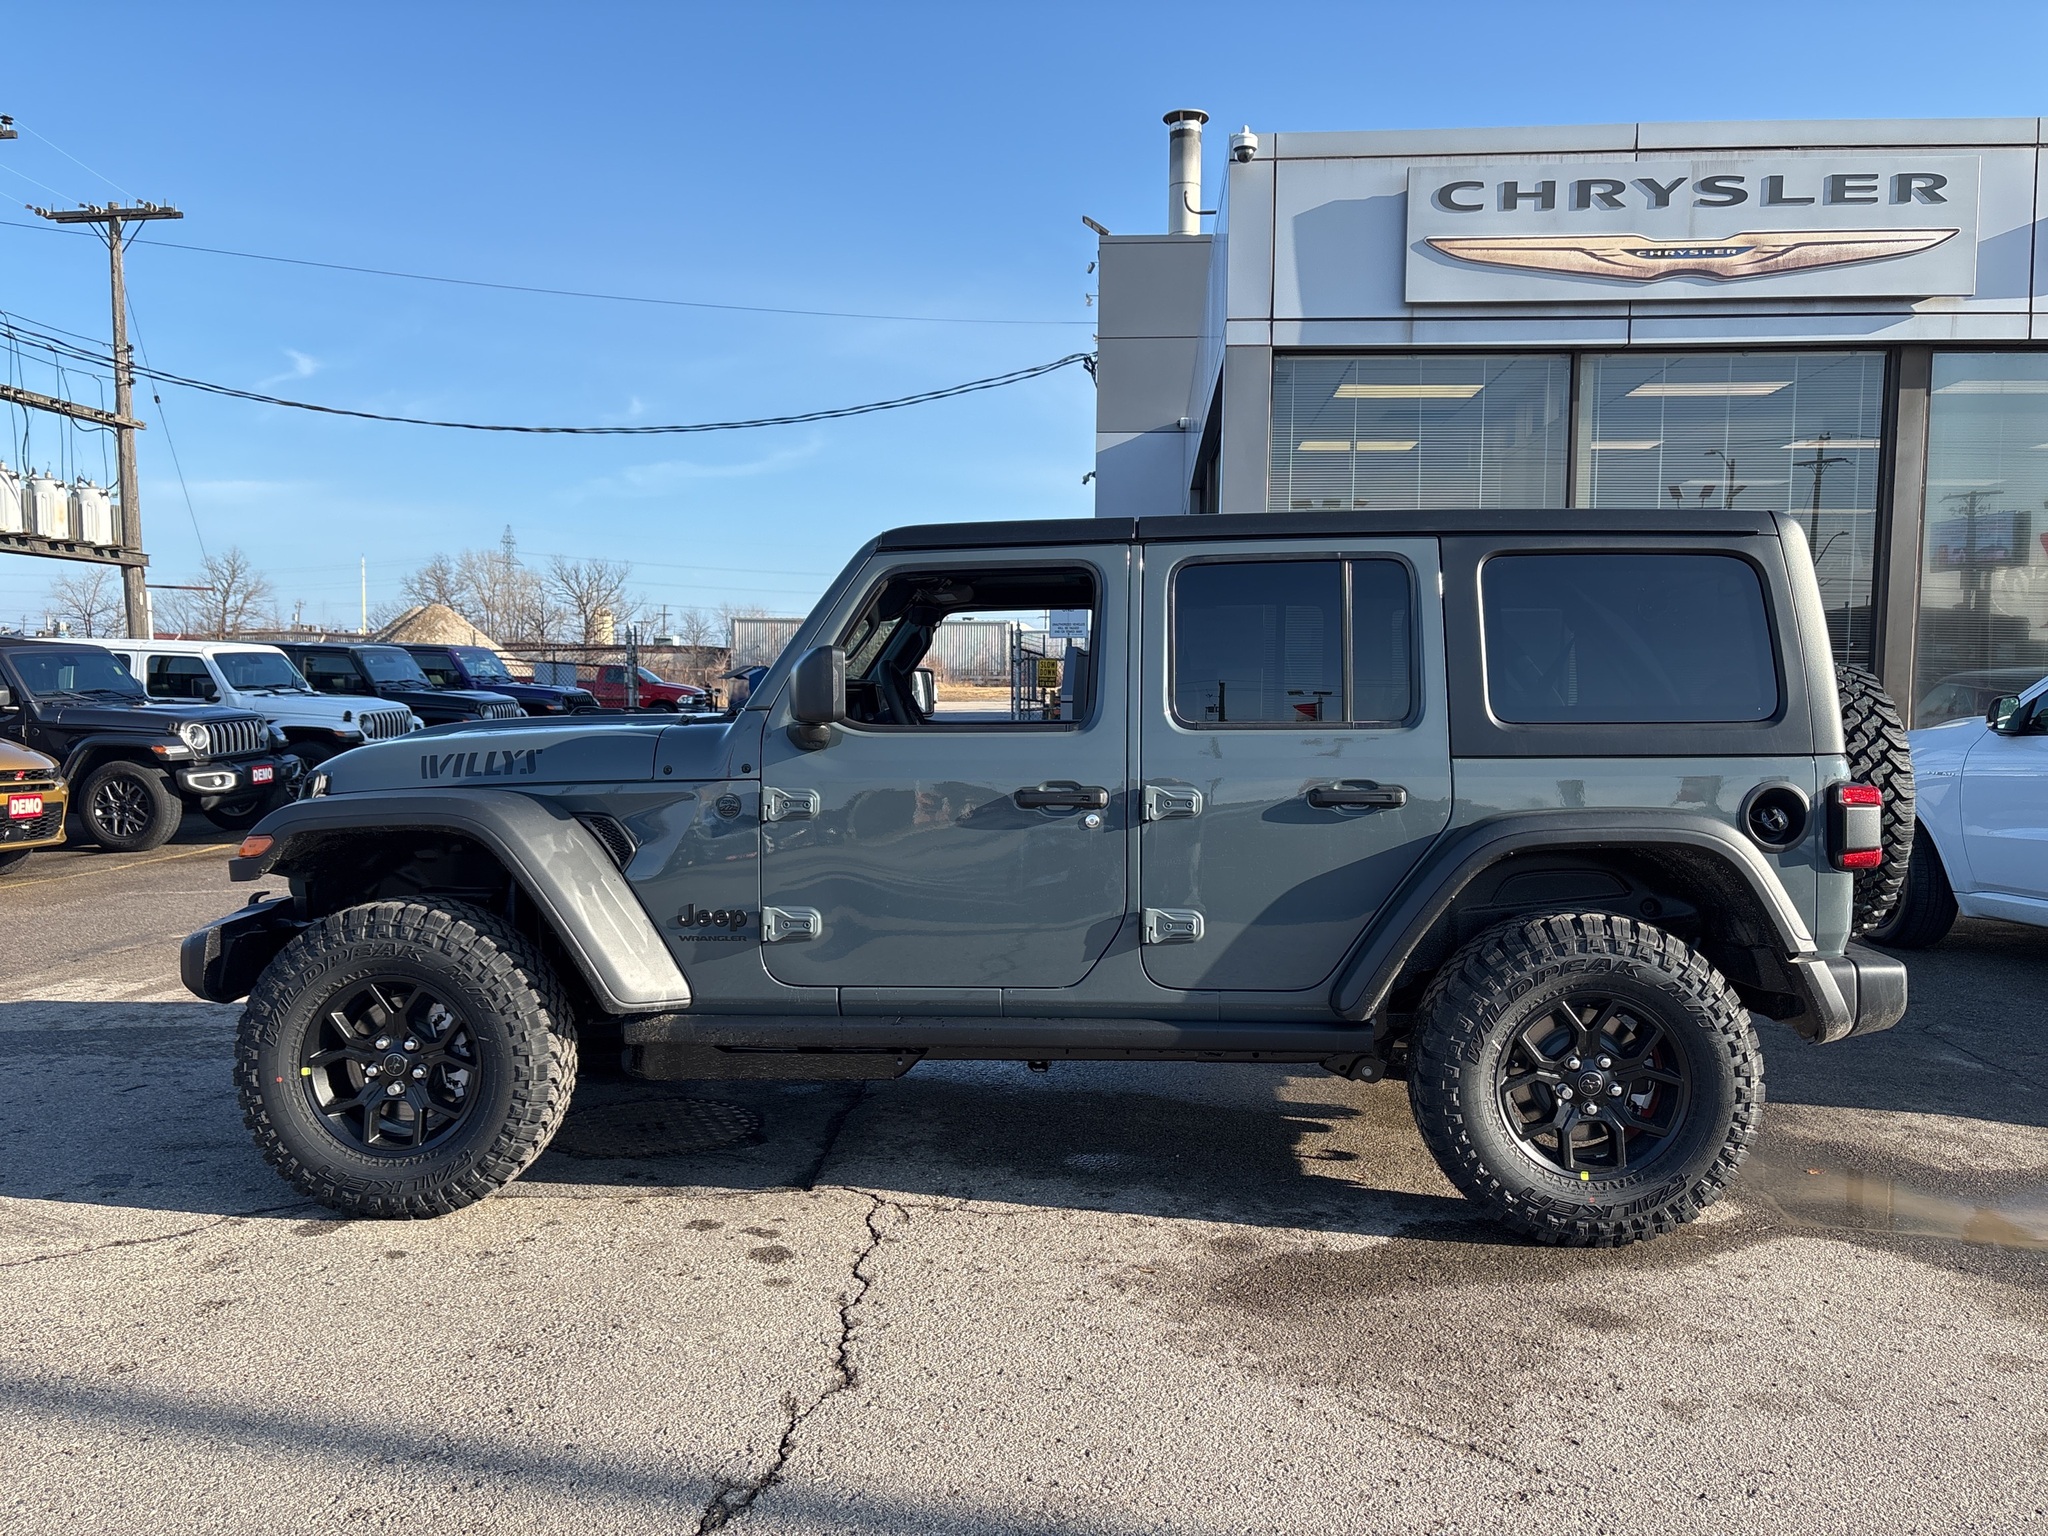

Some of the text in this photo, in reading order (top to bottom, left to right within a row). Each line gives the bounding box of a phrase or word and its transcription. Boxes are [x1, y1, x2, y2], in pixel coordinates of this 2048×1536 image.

[1435, 172, 1949, 212] CHRYSLER
[1635, 248, 1738, 257] CHRYSLER
[252, 766, 274, 782] DEMO
[421, 749, 543, 779] WILLYS
[10, 797, 42, 815] DEMO
[677, 902, 747, 932] Jeep
[264, 942, 428, 1047] WILDPEAK
[1467, 957, 1647, 1065] WILDPEAK
[1520, 1172, 1692, 1219] FALKEN
